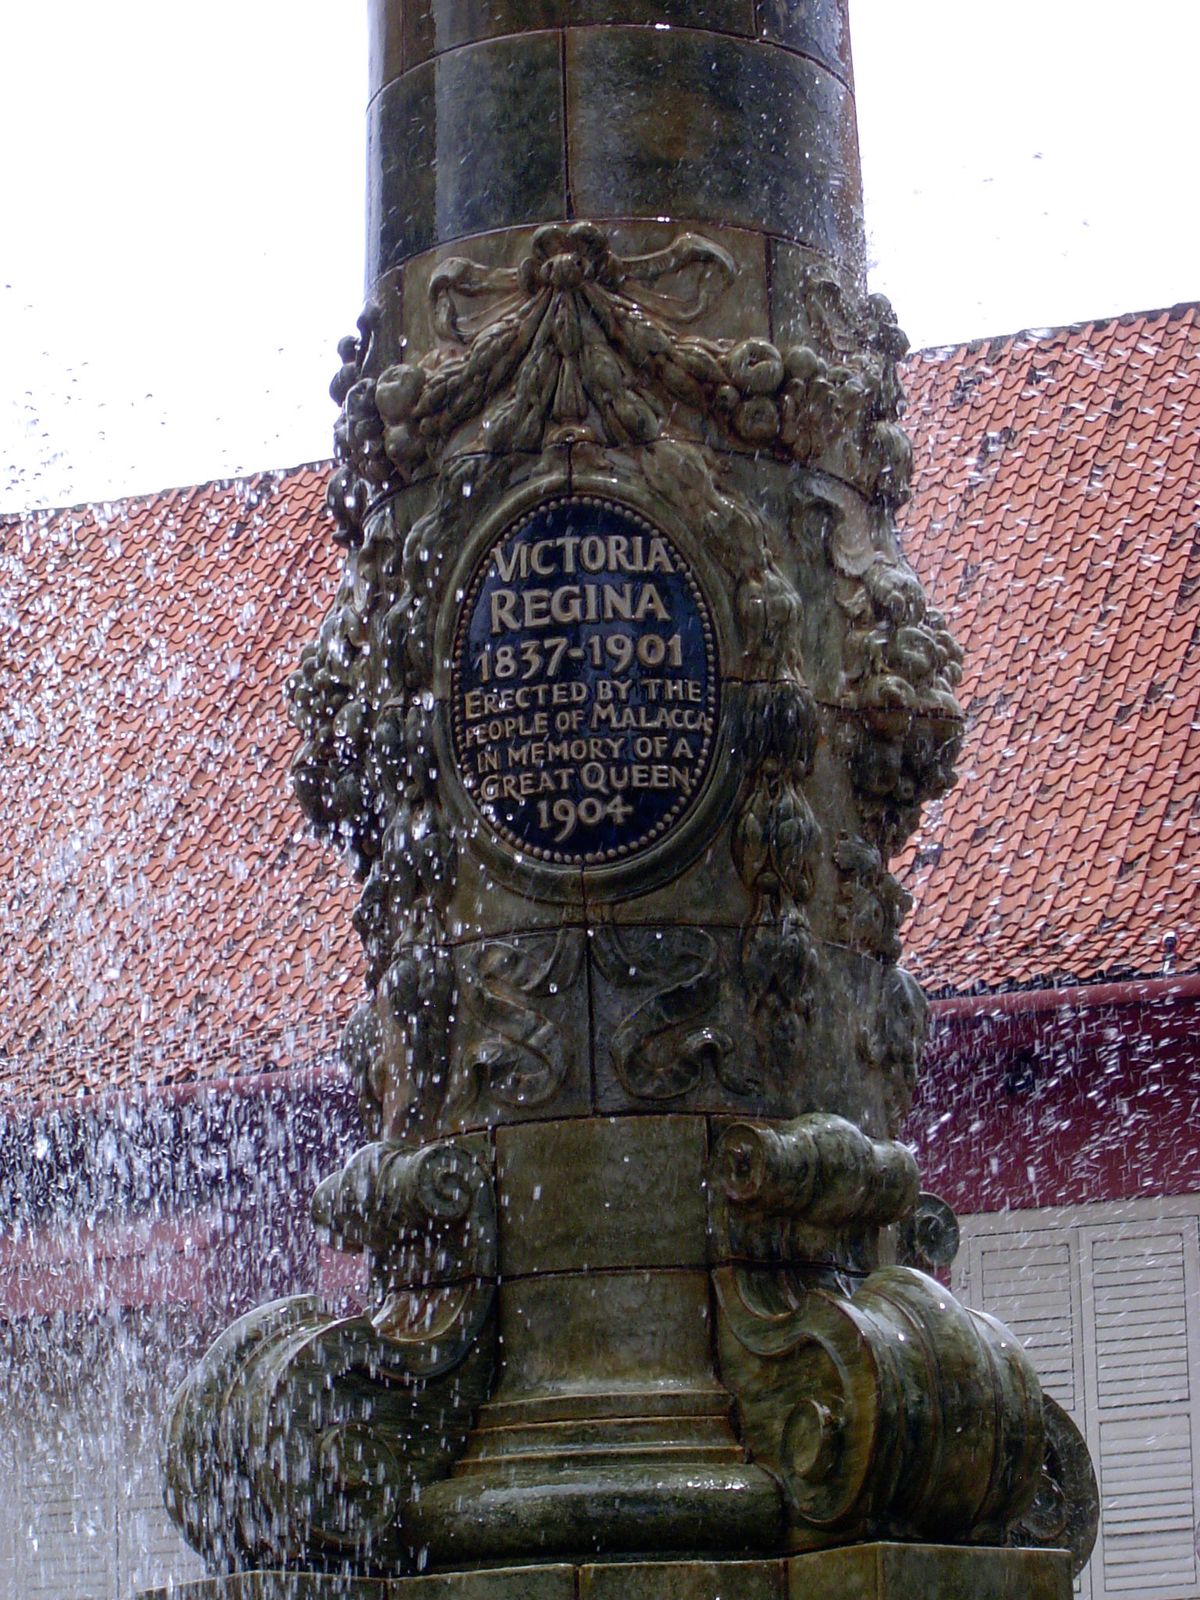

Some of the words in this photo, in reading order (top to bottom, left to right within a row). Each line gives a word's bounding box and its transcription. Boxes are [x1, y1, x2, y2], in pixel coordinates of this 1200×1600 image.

[491, 535, 676, 582] VICTORIA
[490, 584, 671, 635] REGINA
[474, 634, 682, 682] 1837-1901
[465, 681, 588, 719] ERECTED
[597, 681, 633, 701] BY
[641, 679, 702, 702] THE
[465, 711, 548, 747] PEOPLE
[555, 710, 585, 730] OF
[590, 703, 707, 731] MALACCA
[477, 750, 500, 772] IN
[507, 738, 625, 768] MEMORY
[635, 737, 667, 757] OF
[674, 738, 693, 758] A
[480, 768, 574, 801] GREAT
[581, 763, 690, 792] QUEEN
[538, 795, 633, 843] 1904
